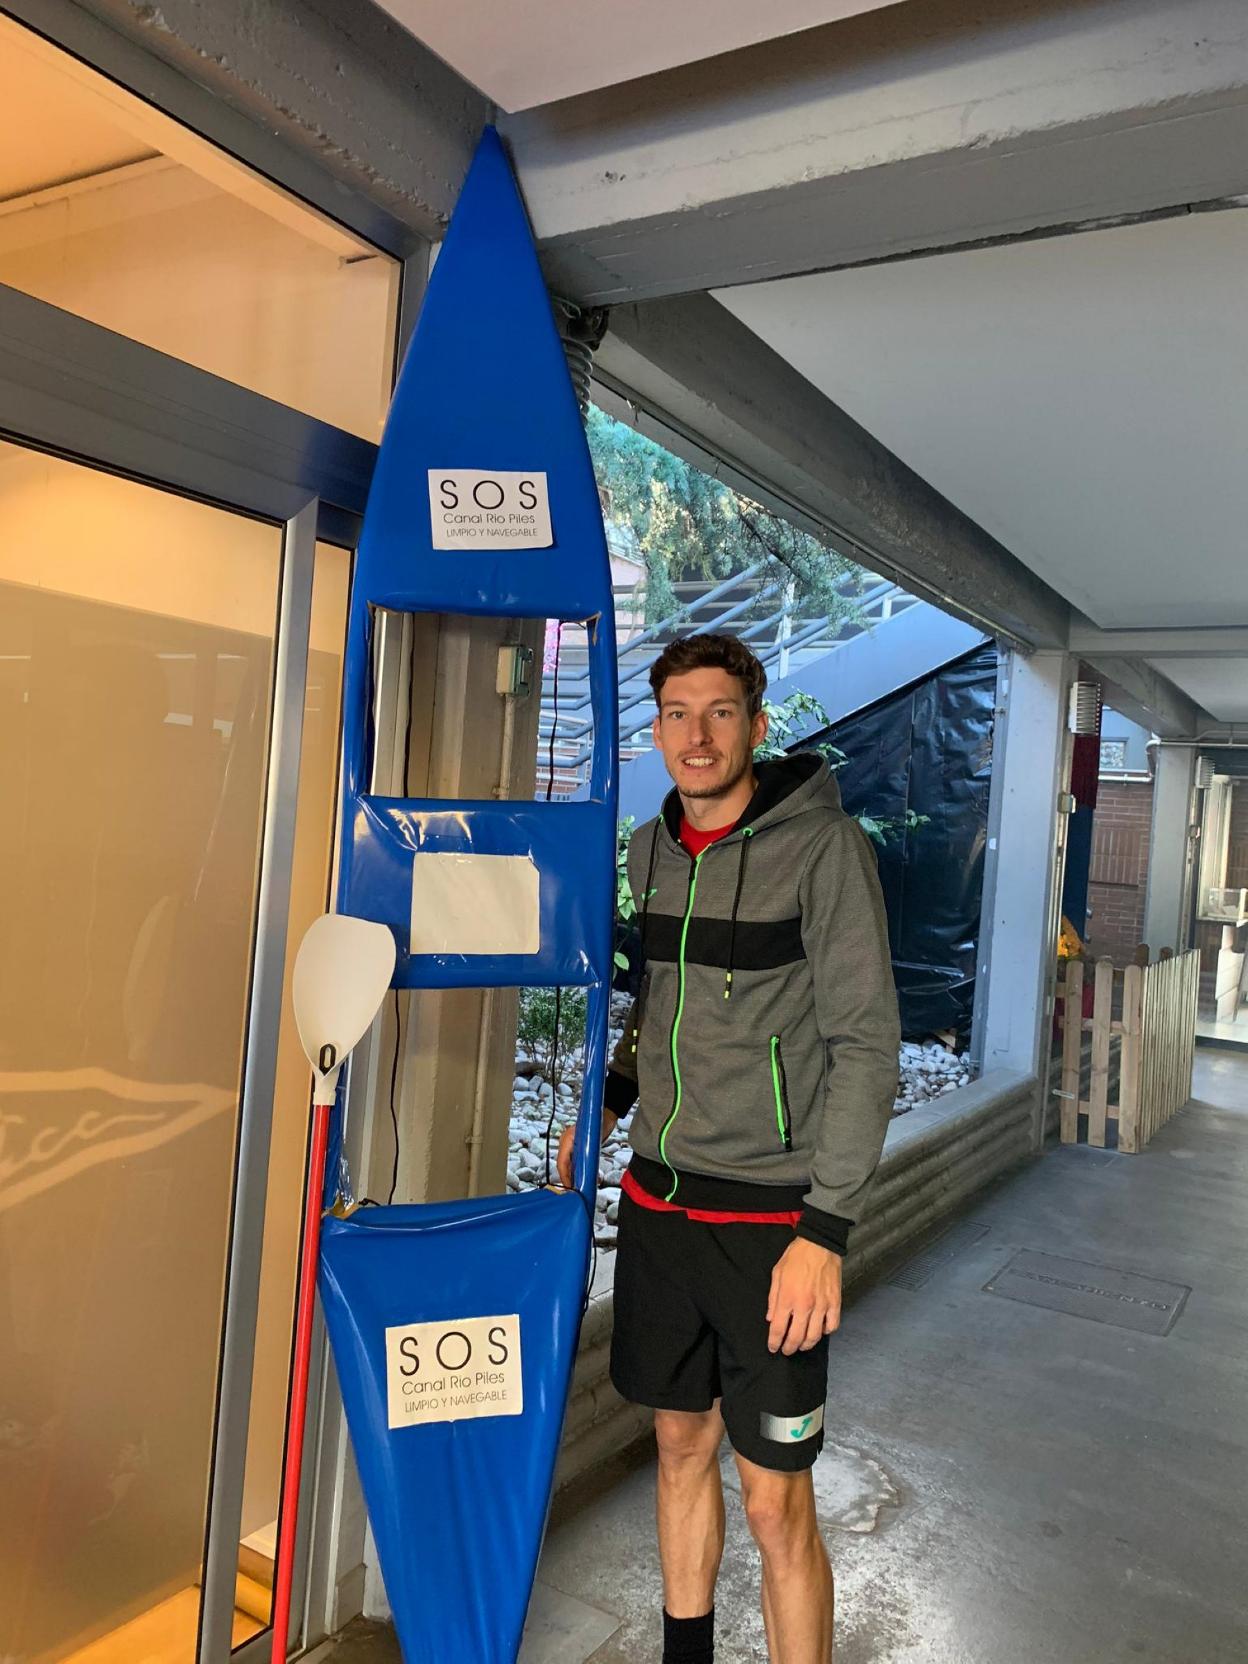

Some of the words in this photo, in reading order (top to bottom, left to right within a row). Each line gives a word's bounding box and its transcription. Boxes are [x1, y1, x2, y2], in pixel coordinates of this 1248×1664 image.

[443, 513, 482, 524] Canal
[486, 513, 505, 524] Rio
[509, 513, 535, 524] Piles
[446, 528, 477, 538] LIMPIO
[479, 528, 485, 537] Y
[487, 528, 538, 537] NAVEGABLE
[402, 1377, 446, 1395] Canal
[450, 1375, 472, 1389] Rio
[475, 1371, 505, 1385] Piles
[405, 1398, 438, 1413] LIMPIO
[440, 1397, 448, 1408] Y
[450, 1389, 507, 1407] NAVEGABLE
